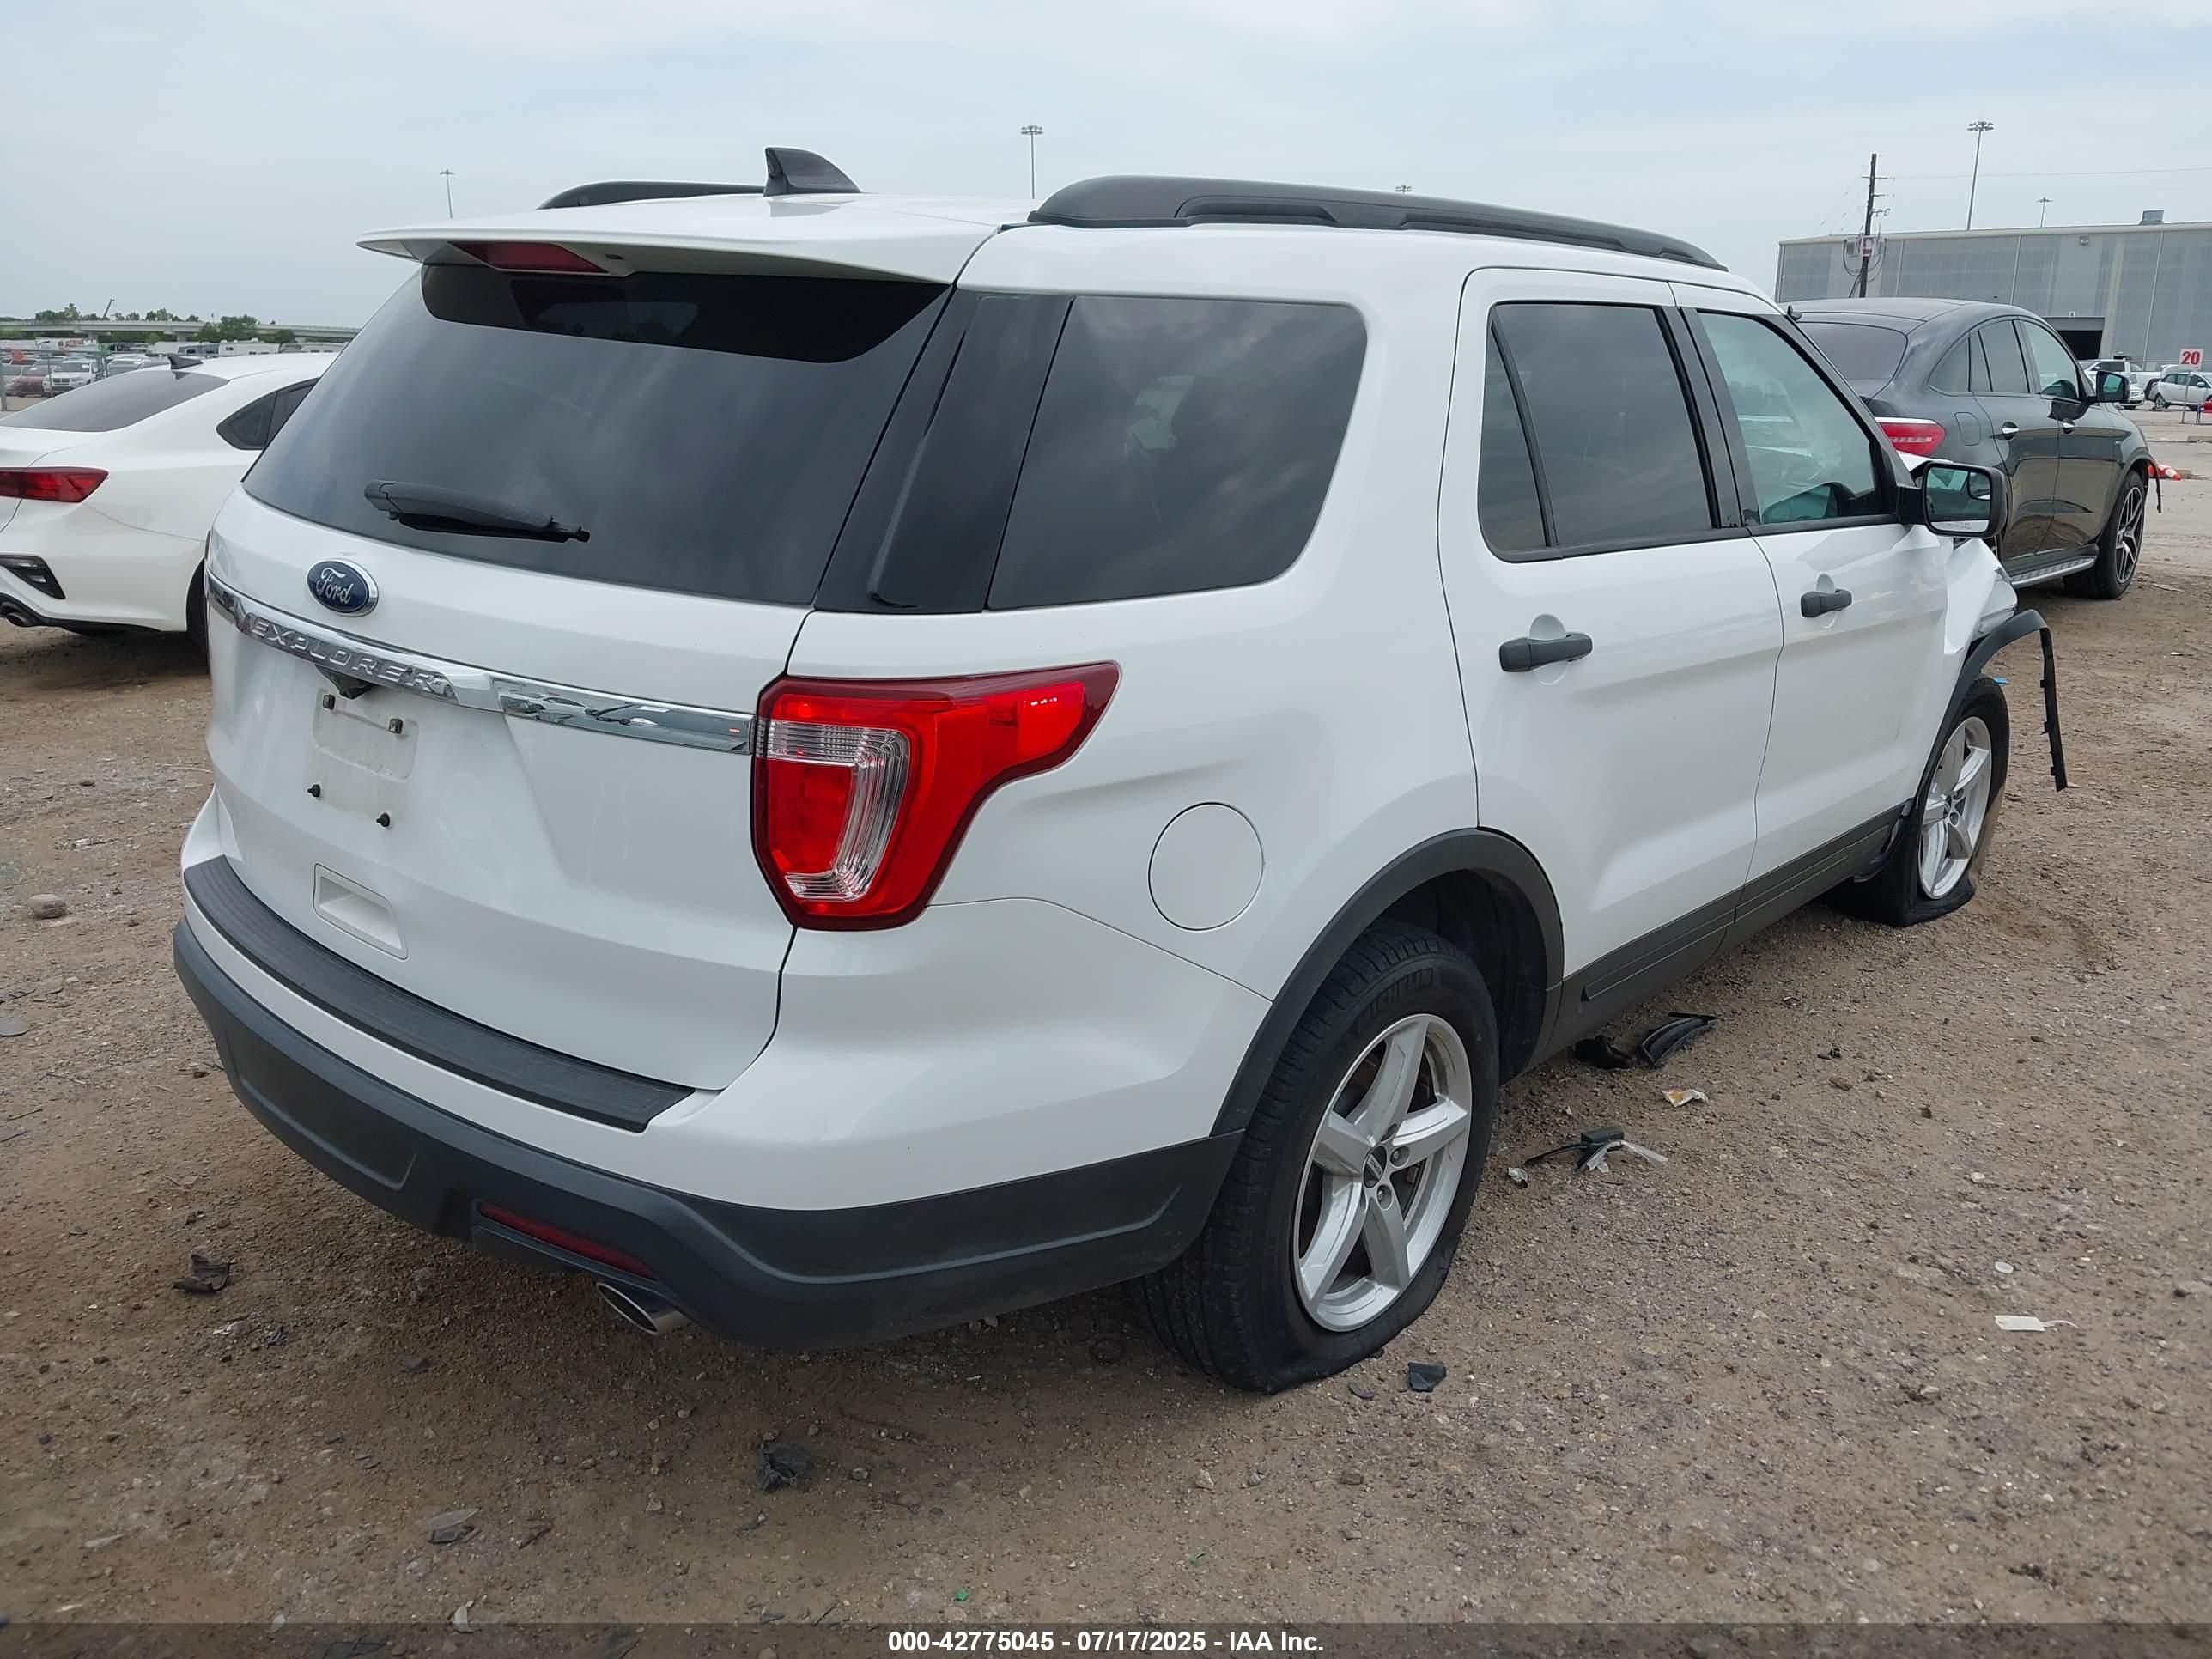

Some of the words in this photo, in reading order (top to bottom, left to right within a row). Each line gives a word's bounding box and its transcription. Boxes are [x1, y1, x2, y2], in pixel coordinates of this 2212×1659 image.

[2181, 350, 2200, 365] 20
[315, 567, 354, 605] Ford
[251, 616, 435, 693] EXPLORER
